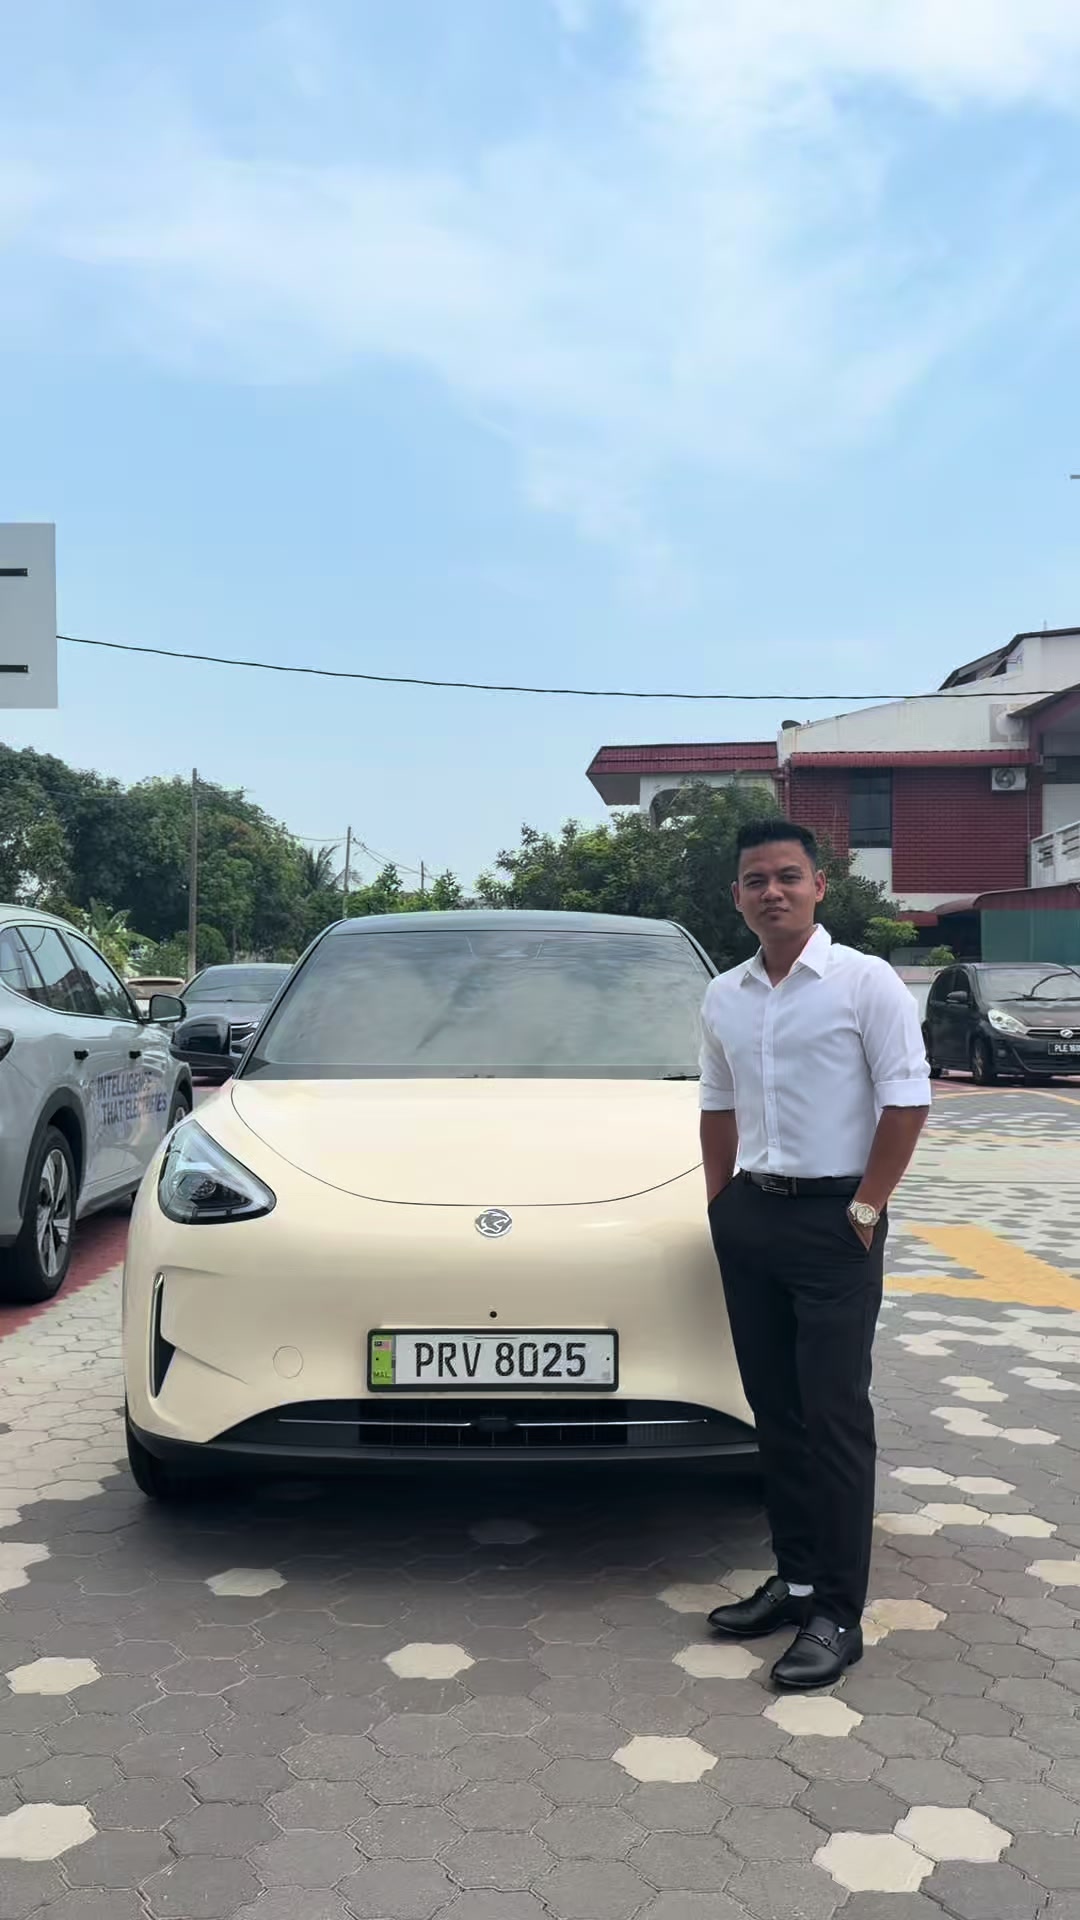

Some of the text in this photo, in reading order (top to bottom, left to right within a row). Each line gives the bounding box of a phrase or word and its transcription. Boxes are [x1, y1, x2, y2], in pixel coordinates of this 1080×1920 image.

[1054, 1044, 1069, 1053] PLE
[101, 1101, 123, 1125] THAT
[414, 1342, 586, 1377] PRV 8025
